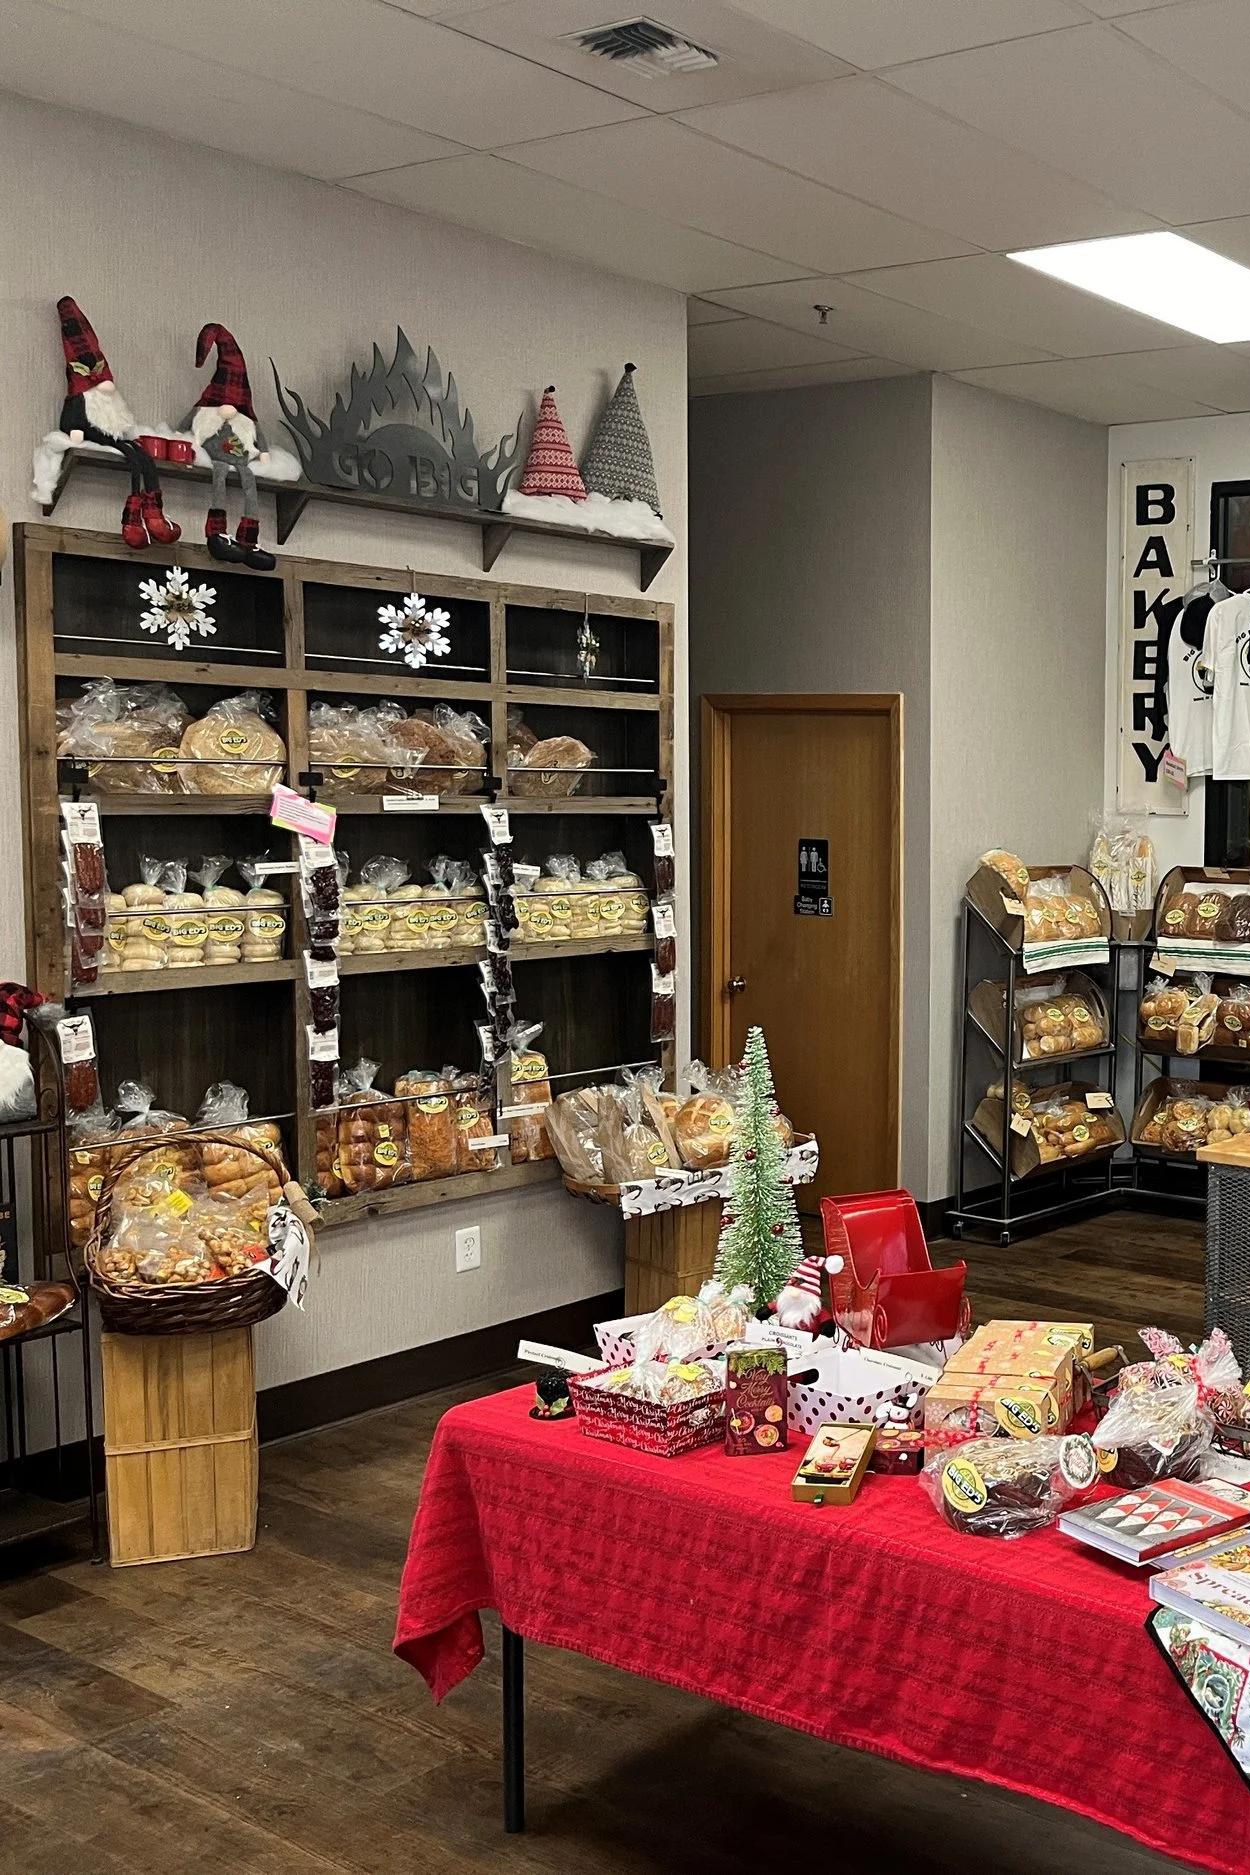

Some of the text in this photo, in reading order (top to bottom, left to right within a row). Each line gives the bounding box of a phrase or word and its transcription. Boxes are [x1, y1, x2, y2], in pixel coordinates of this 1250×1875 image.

[332, 443, 480, 503] GO BIG
[1132, 483, 1176, 783] BAKERY
[744, 1368, 772, 1386] Very
[1001, 1397, 1041, 1435] BIG ED'S
[948, 1464, 984, 1505] BIG ED'S
